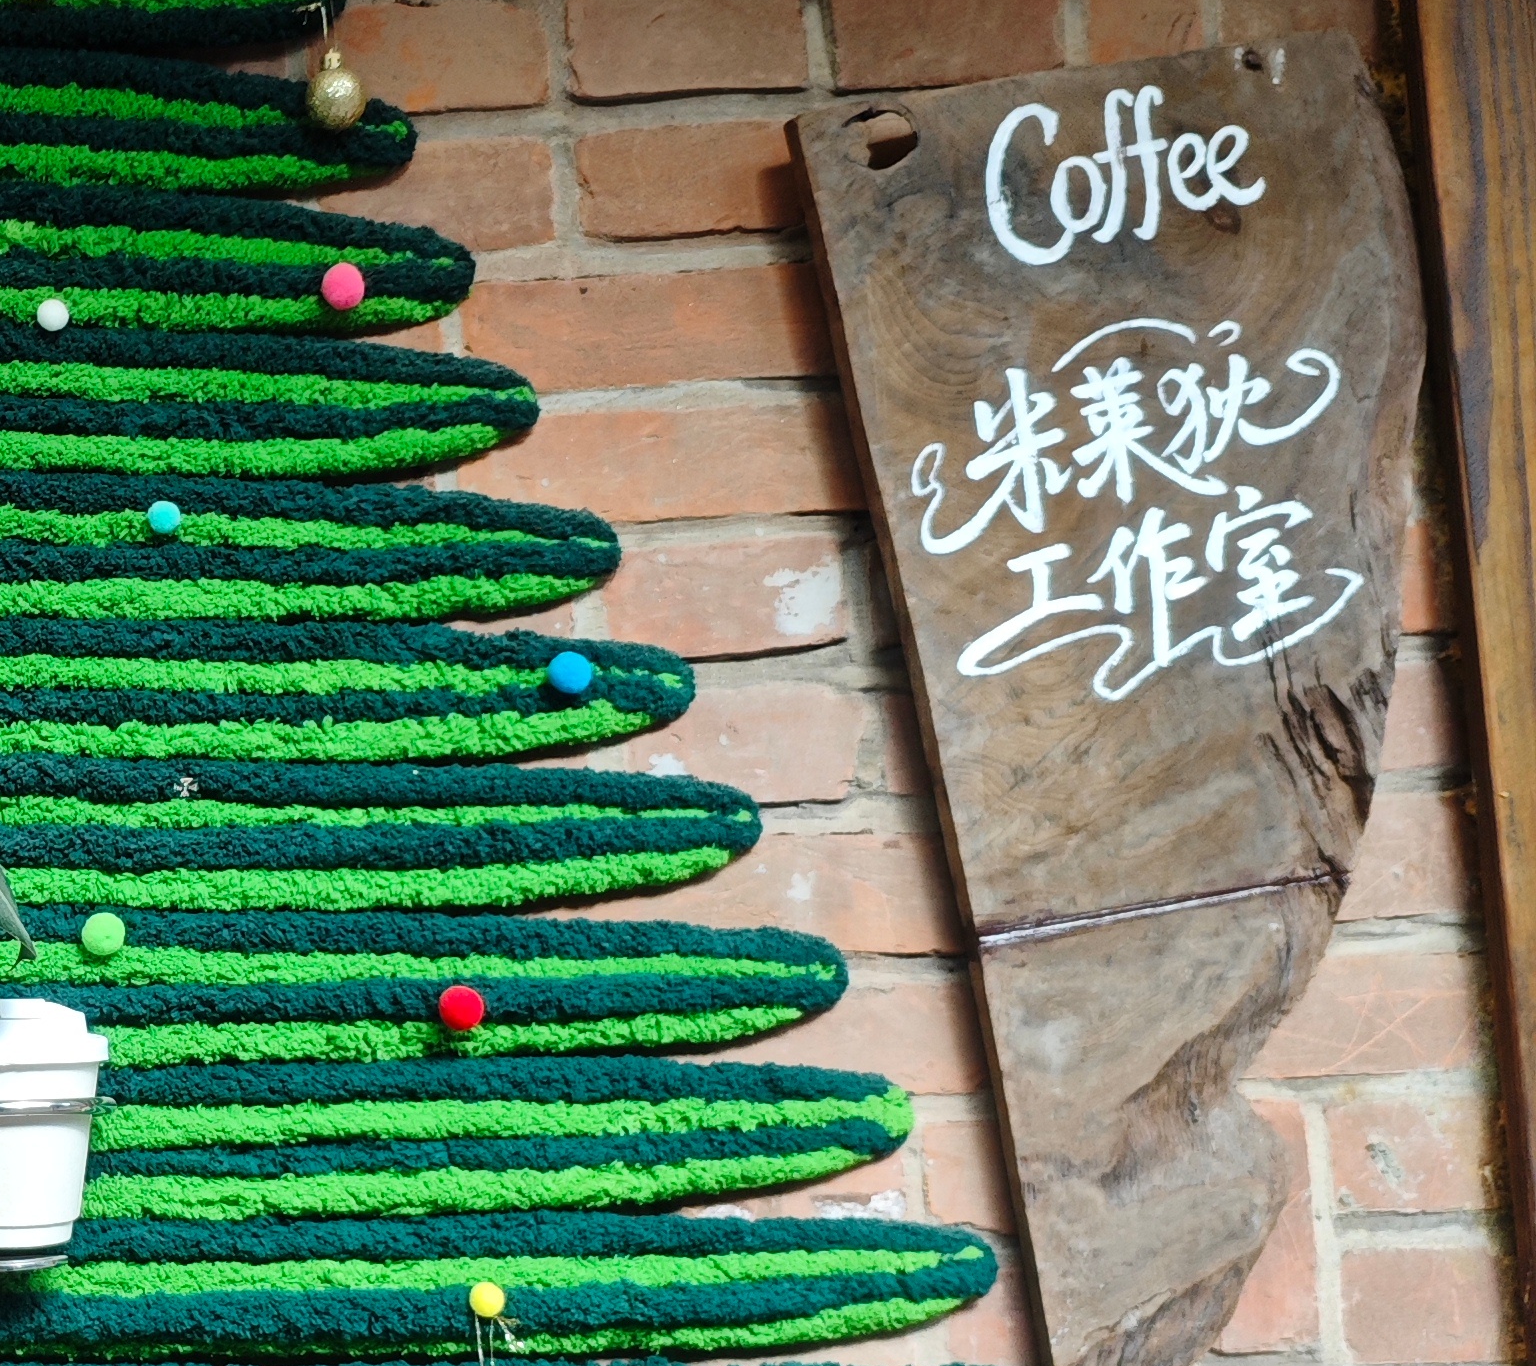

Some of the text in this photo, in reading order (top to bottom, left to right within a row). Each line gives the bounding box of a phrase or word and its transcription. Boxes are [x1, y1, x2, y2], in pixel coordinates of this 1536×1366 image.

[985, 84, 1266, 266] Coffee
[956, 485, 1366, 702] 工作室
